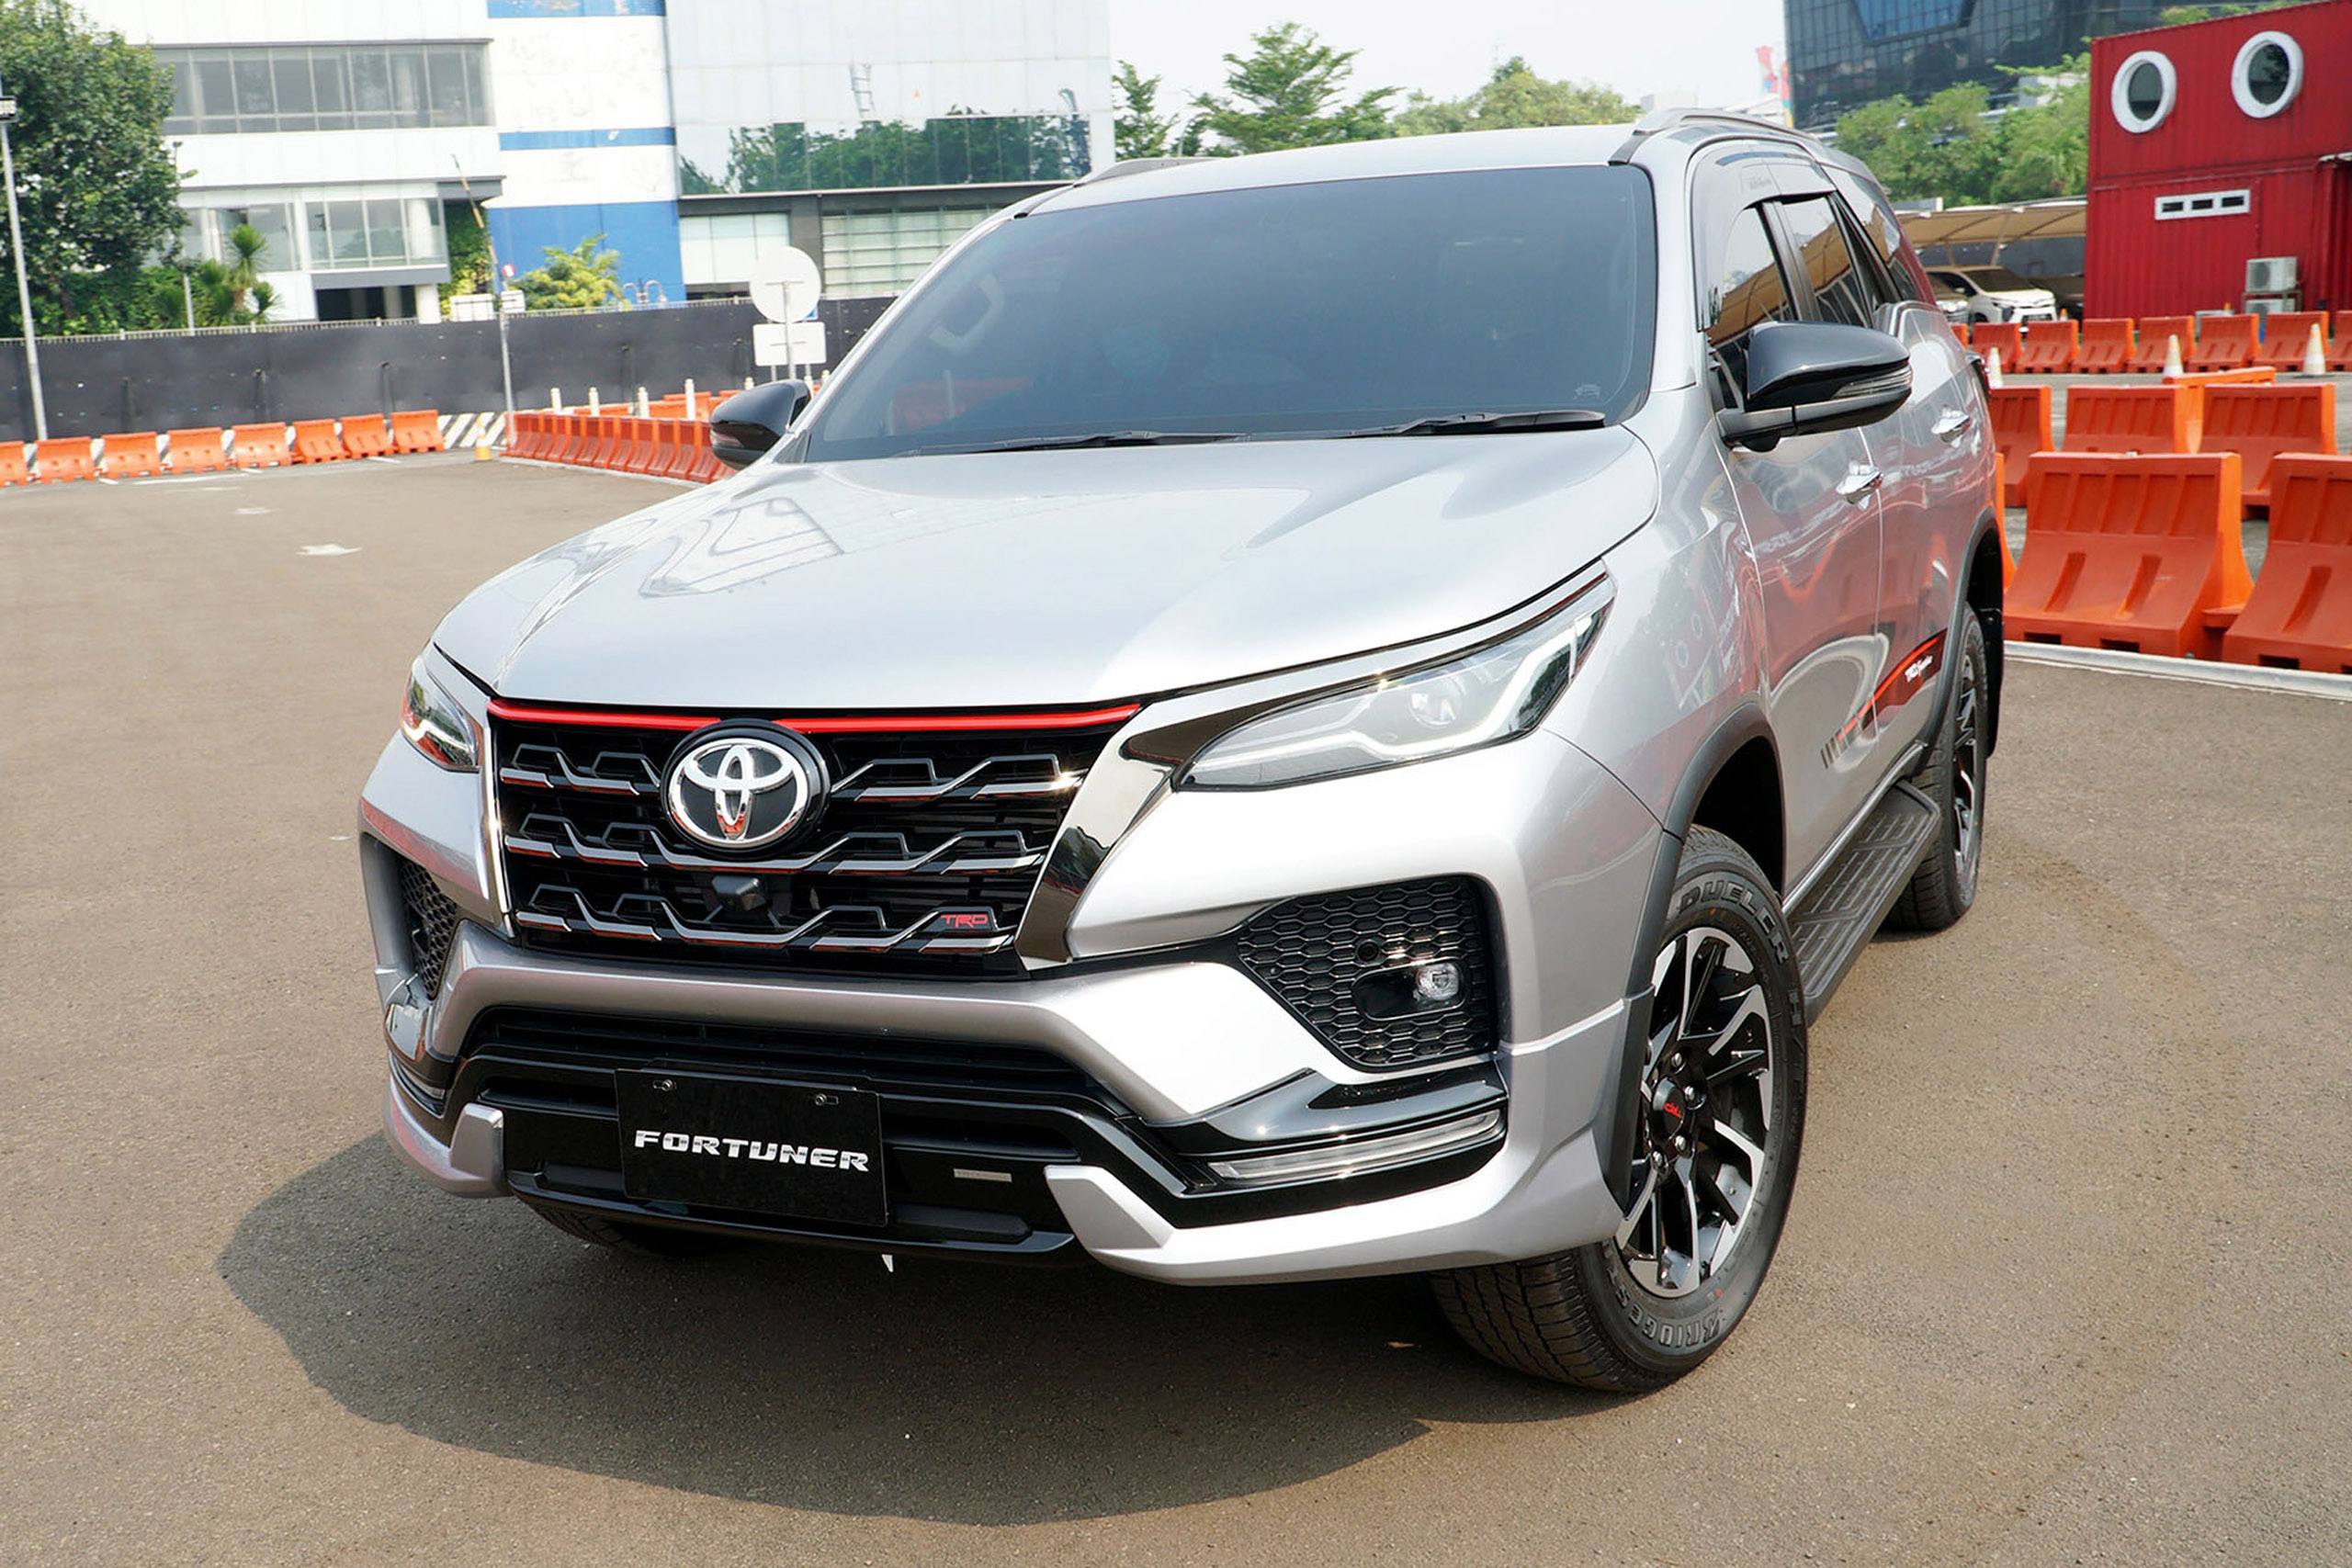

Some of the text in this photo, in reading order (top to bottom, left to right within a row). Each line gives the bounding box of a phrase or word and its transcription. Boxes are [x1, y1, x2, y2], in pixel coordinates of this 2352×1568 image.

[940, 914, 989, 929] TRD
[1679, 880, 1789, 964] DUELER
[634, 1130, 869, 1172] FORTUNER
[1602, 1240, 1723, 1348] BRIDGEST
